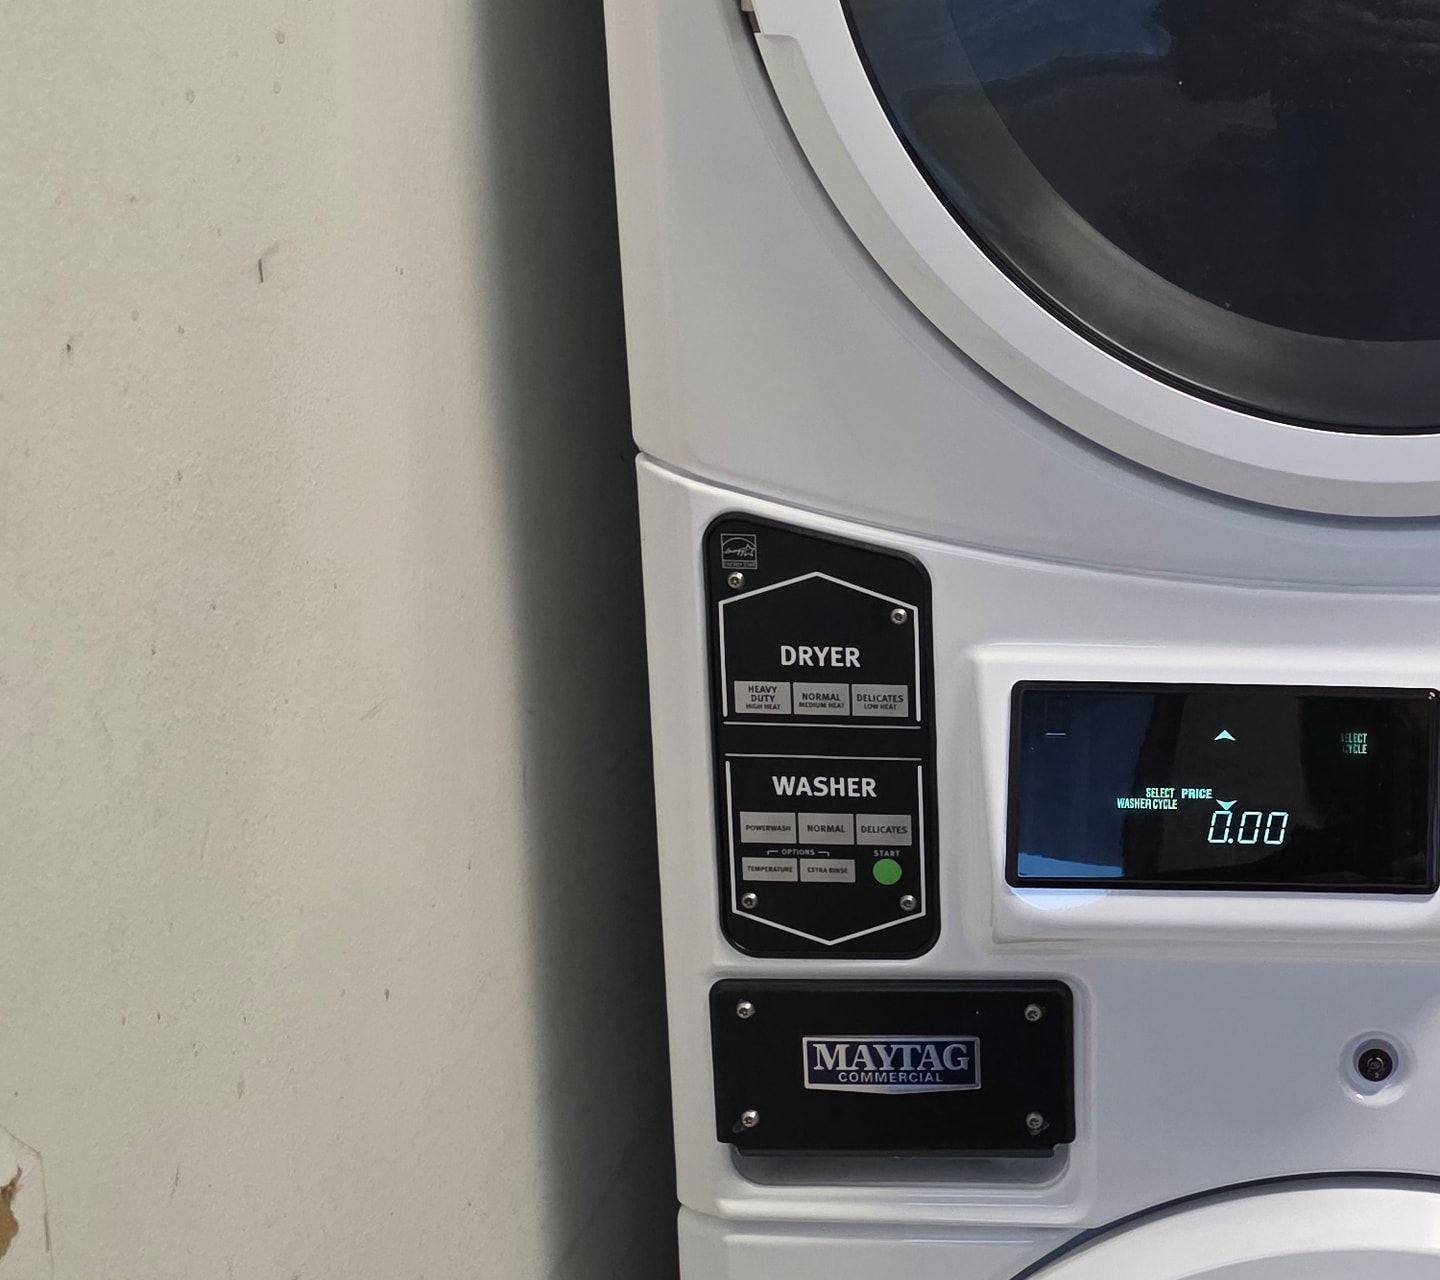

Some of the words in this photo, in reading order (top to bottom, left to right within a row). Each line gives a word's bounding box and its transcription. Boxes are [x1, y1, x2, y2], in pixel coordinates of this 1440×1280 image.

[780, 645, 861, 667] DRYER
[748, 685, 778, 694] HEAVY
[751, 694, 776, 702] DUTY
[802, 692, 841, 702] NORMAL
[856, 694, 904, 703] DELICATES
[772, 776, 877, 798] WASHER
[1146, 787, 1175, 799] SELECT
[1181, 788, 1212, 799] PRICE
[1117, 798, 1151, 809] WASHER
[1152, 798, 1178, 810] CYCLE
[807, 824, 846, 833] NORMAL
[861, 825, 908, 834] DELICATES
[1207, 810, 1289, 845] 0.00
[781, 848, 815, 856] OPTIONS
[812, 1043, 970, 1071] MAYTAG
[838, 1072, 944, 1083] COMMERCIAL
